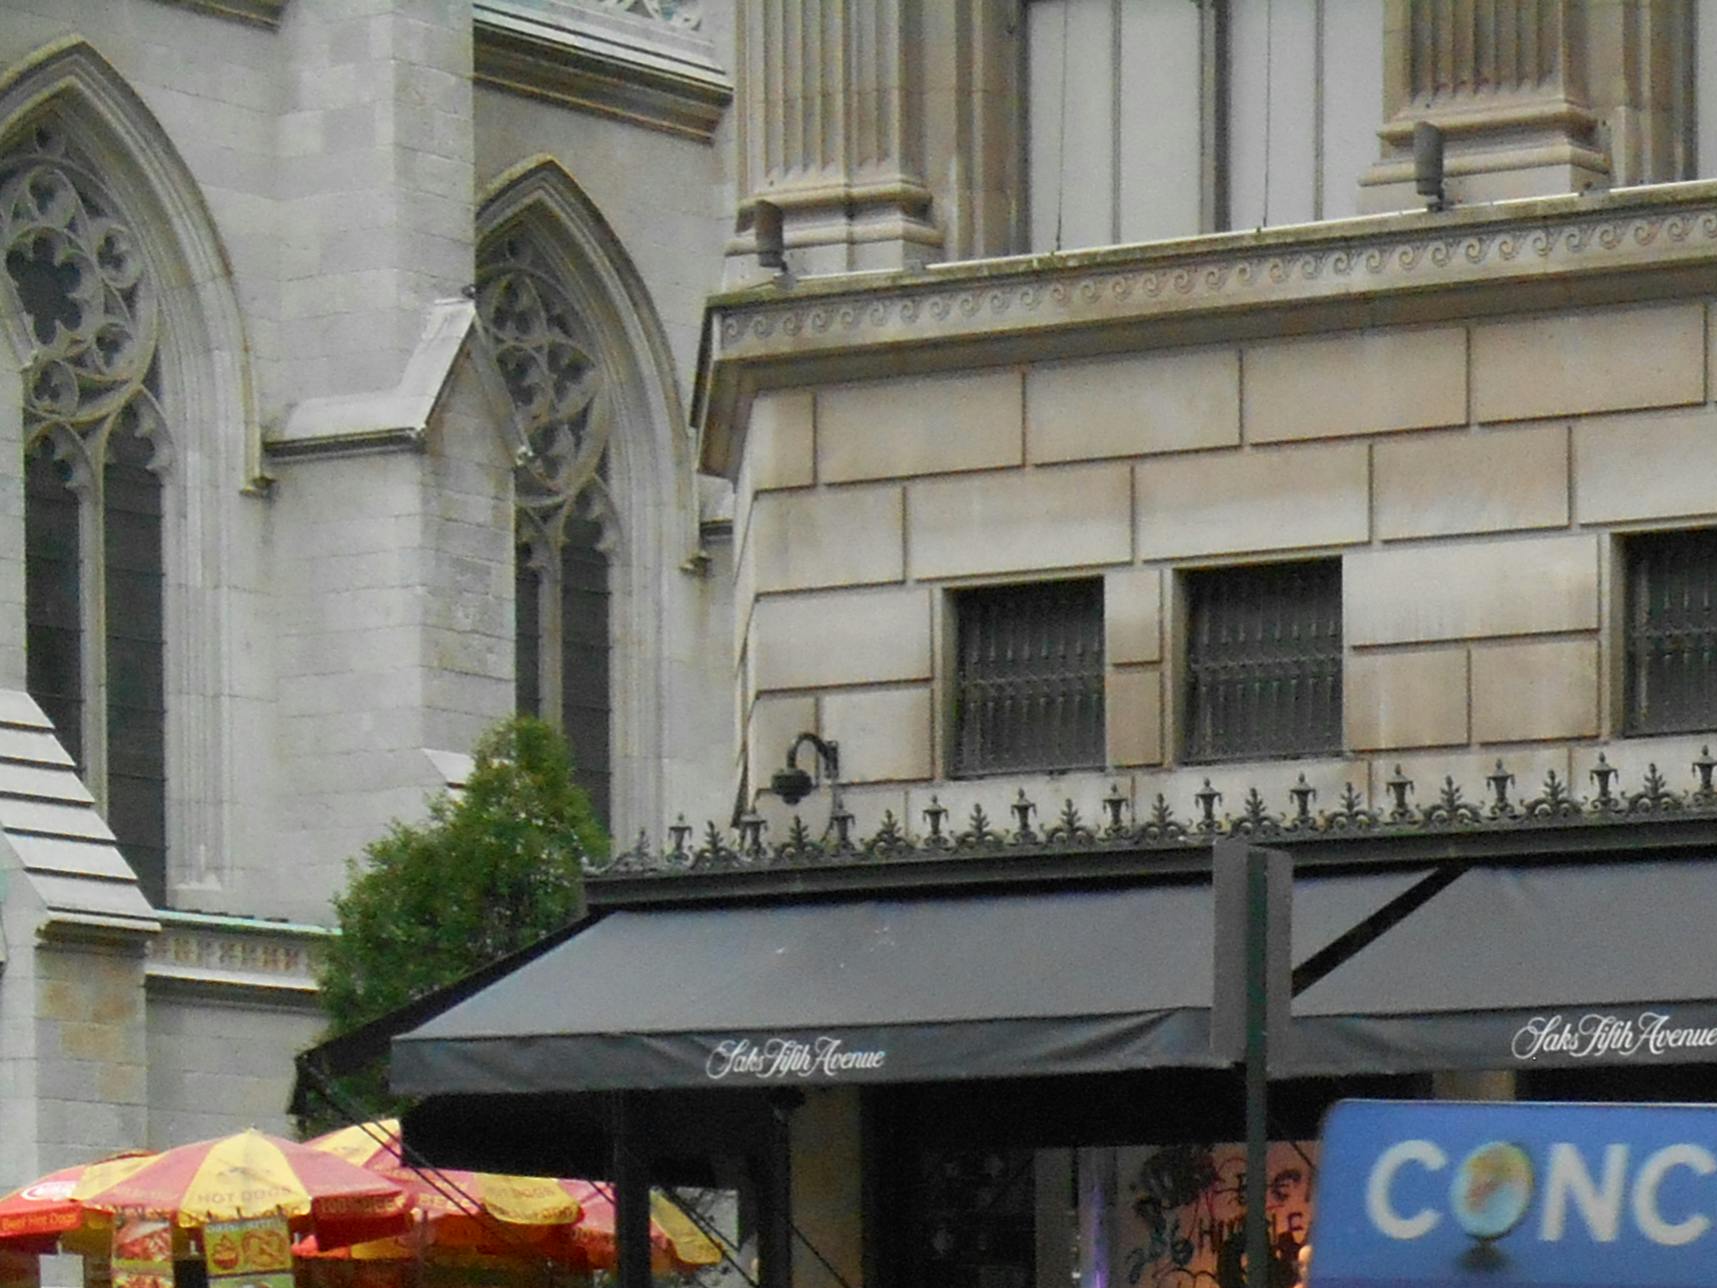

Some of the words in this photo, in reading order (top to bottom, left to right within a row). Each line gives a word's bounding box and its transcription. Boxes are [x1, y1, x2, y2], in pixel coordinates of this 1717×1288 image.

[706, 1039, 764, 1079] Saks
[756, 1038, 810, 1078] Fifth
[798, 1036, 886, 1077] Avenue
[1512, 1015, 1579, 1059] Saks
[1569, 1014, 1633, 1057] Fifth
